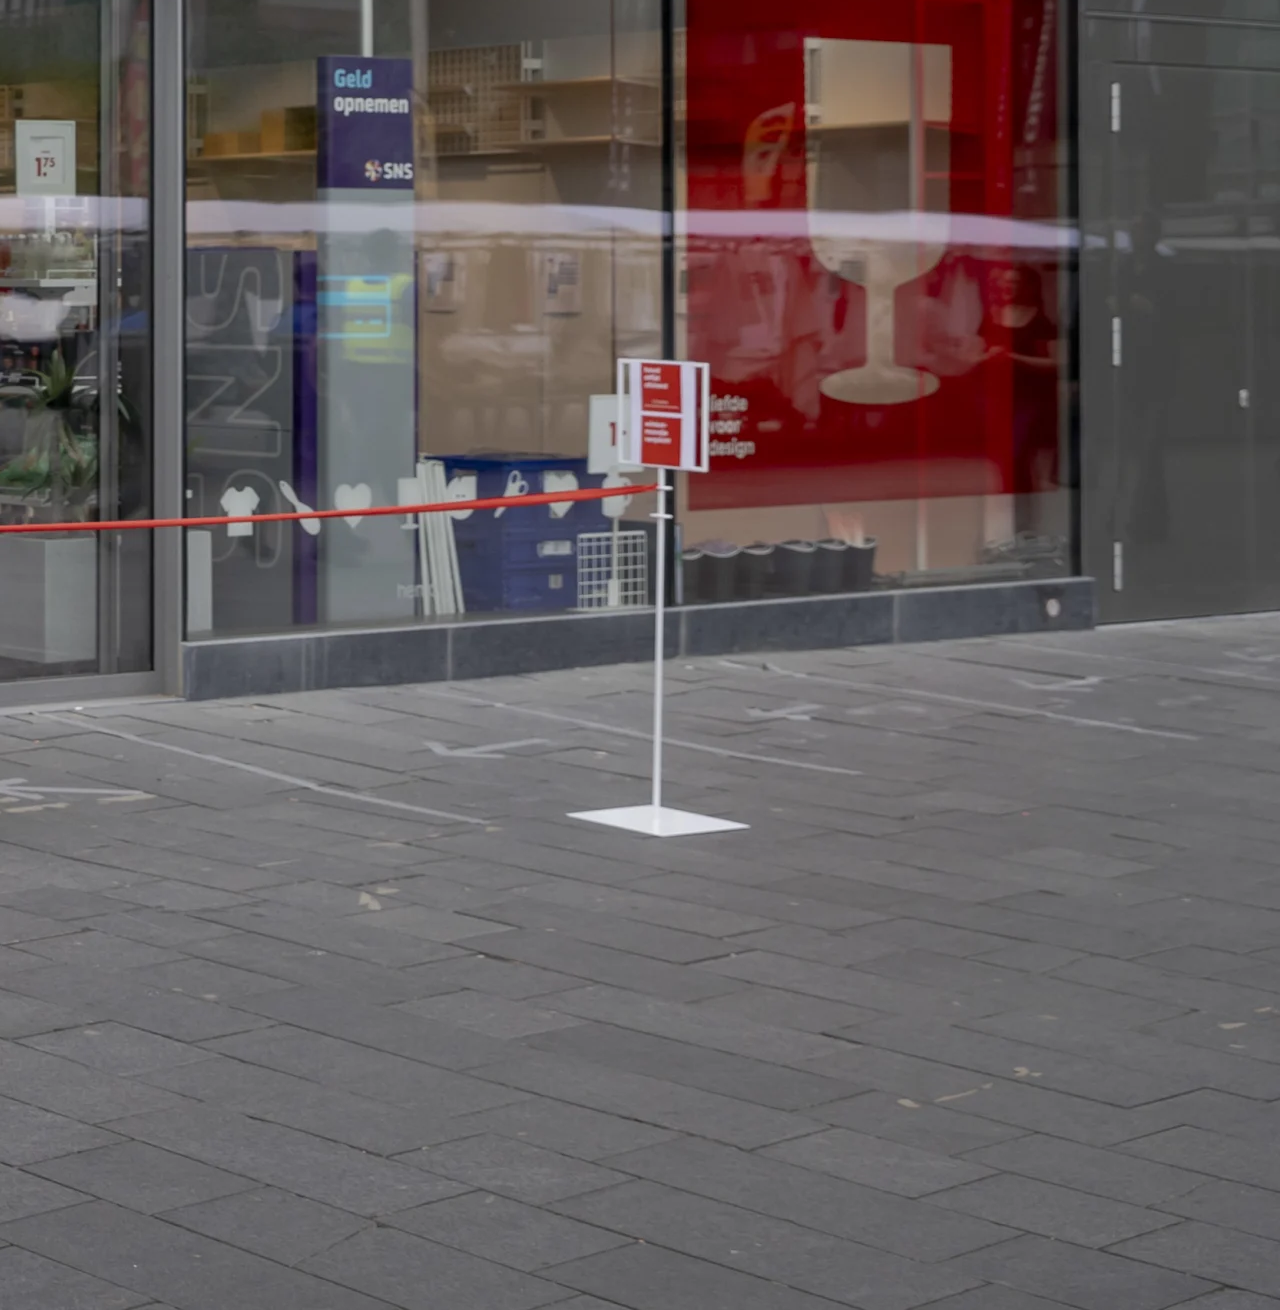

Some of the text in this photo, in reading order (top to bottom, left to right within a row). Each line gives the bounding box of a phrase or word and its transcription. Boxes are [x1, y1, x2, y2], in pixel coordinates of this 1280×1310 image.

[334, 68, 373, 89] Geld
[333, 96, 409, 116] opnemen
[383, 162, 414, 180] SNS
